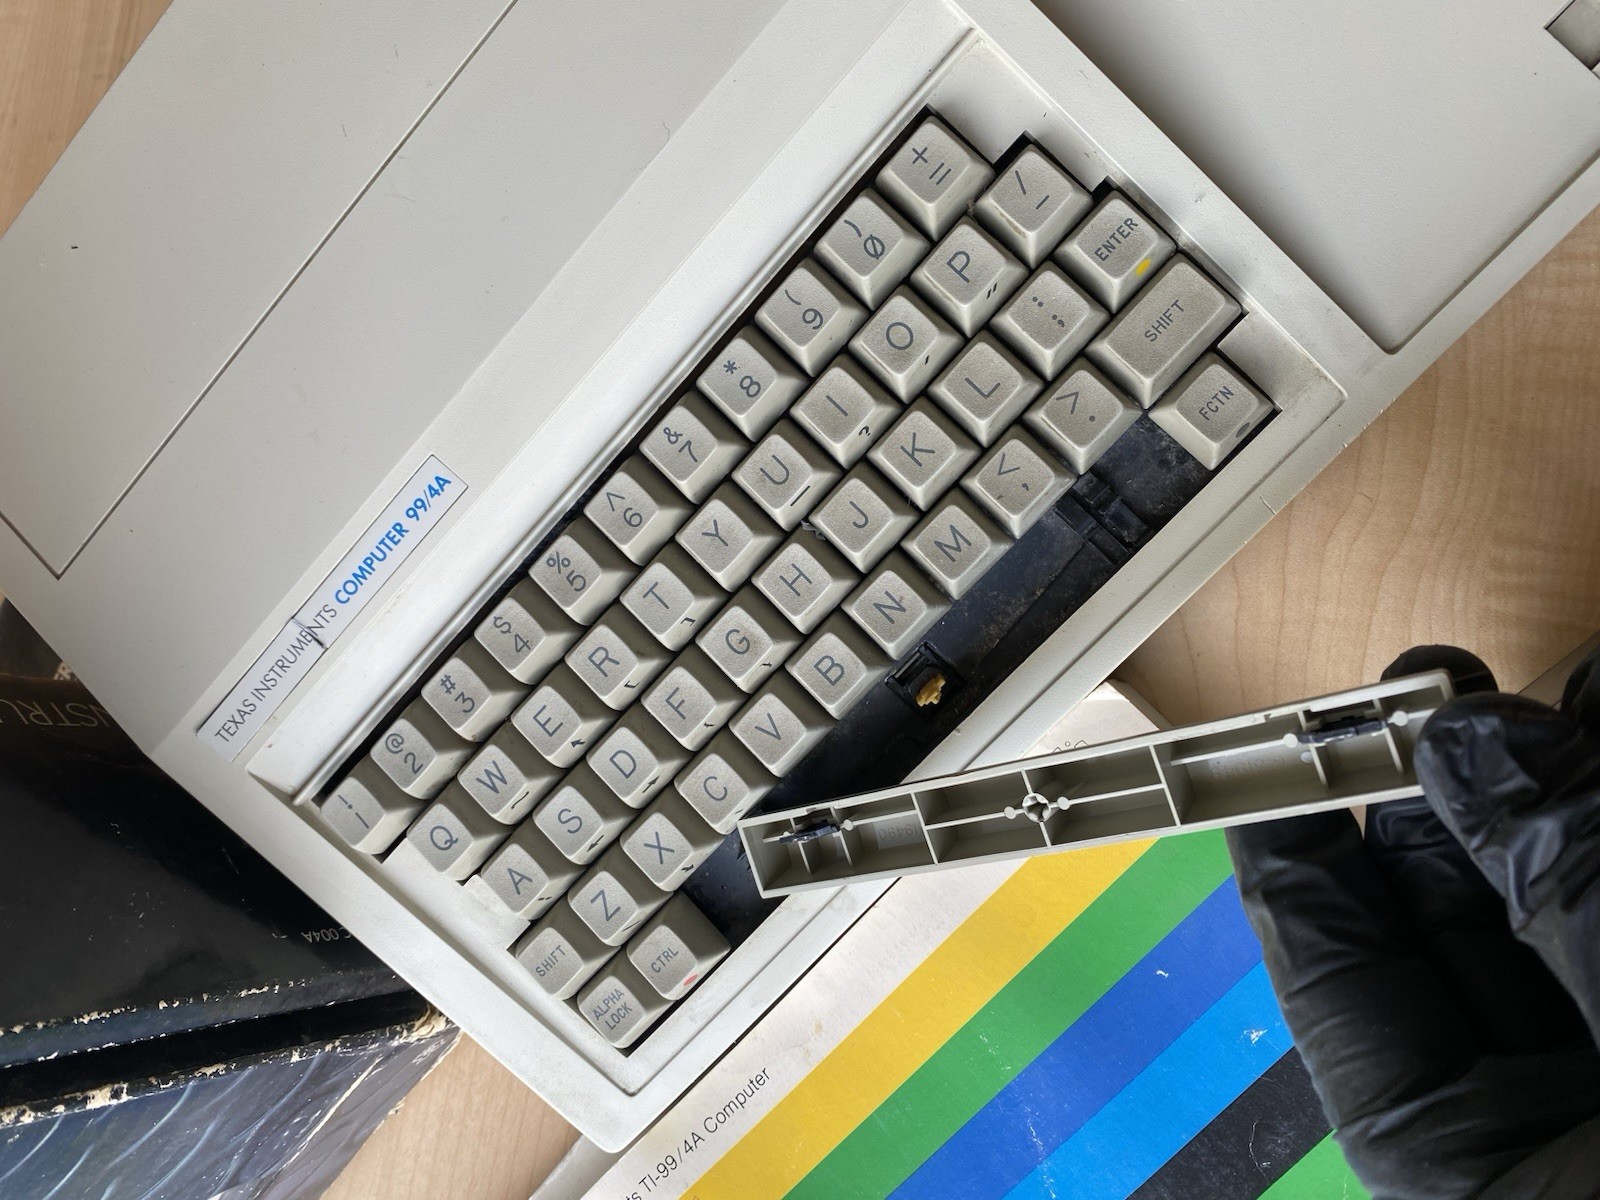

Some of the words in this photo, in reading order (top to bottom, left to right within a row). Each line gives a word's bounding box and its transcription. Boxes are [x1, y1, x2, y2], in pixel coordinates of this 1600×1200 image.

[1093, 216, 1140, 262] ENTER
[946, 250, 971, 283] P
[801, 307, 824, 330] 9
[1143, 299, 1186, 343] SHIFT
[739, 374, 762, 398] 8
[964, 377, 1001, 399] L
[1198, 385, 1236, 421] FCTN
[678, 439, 699, 463] 7
[899, 431, 936, 467] K
[759, 453, 790, 486] U
[622, 506, 643, 528] 6
[849, 500, 869, 529] J
[700, 518, 729, 547] Y
[933, 523, 972, 563] M
[566, 569, 587, 592] 5
[641, 580, 671, 610] T
[779, 562, 813, 597] H
[214, 699, 258, 744] TEXAS
[249, 603, 338, 704] INSTRUMENTS
[334, 520, 410, 606] COMPUTER
[404, 474, 452, 522] 99/4A
[872, 589, 908, 625] N
[513, 632, 532, 654] 4
[724, 627, 751, 655] G
[587, 645, 621, 678] R
[812, 654, 845, 687] B
[454, 690, 476, 714] 3
[664, 686, 687, 720] F
[531, 704, 564, 738] E
[754, 712, 782, 741] V
[403, 751, 424, 775] 2
[475, 759, 509, 795] W
[608, 748, 638, 779] D
[702, 775, 728, 802] C
[556, 807, 584, 835] S
[428, 824, 460, 851] Q
[642, 830, 675, 865] X
[506, 866, 534, 896] A
[589, 888, 622, 922] Z
[534, 944, 567, 978] SHIFT
[650, 946, 680, 974] CTRL
[592, 987, 626, 1021] ALPHA
[603, 1001, 634, 1031] LOCK
[702, 1066, 771, 1135] Computer
